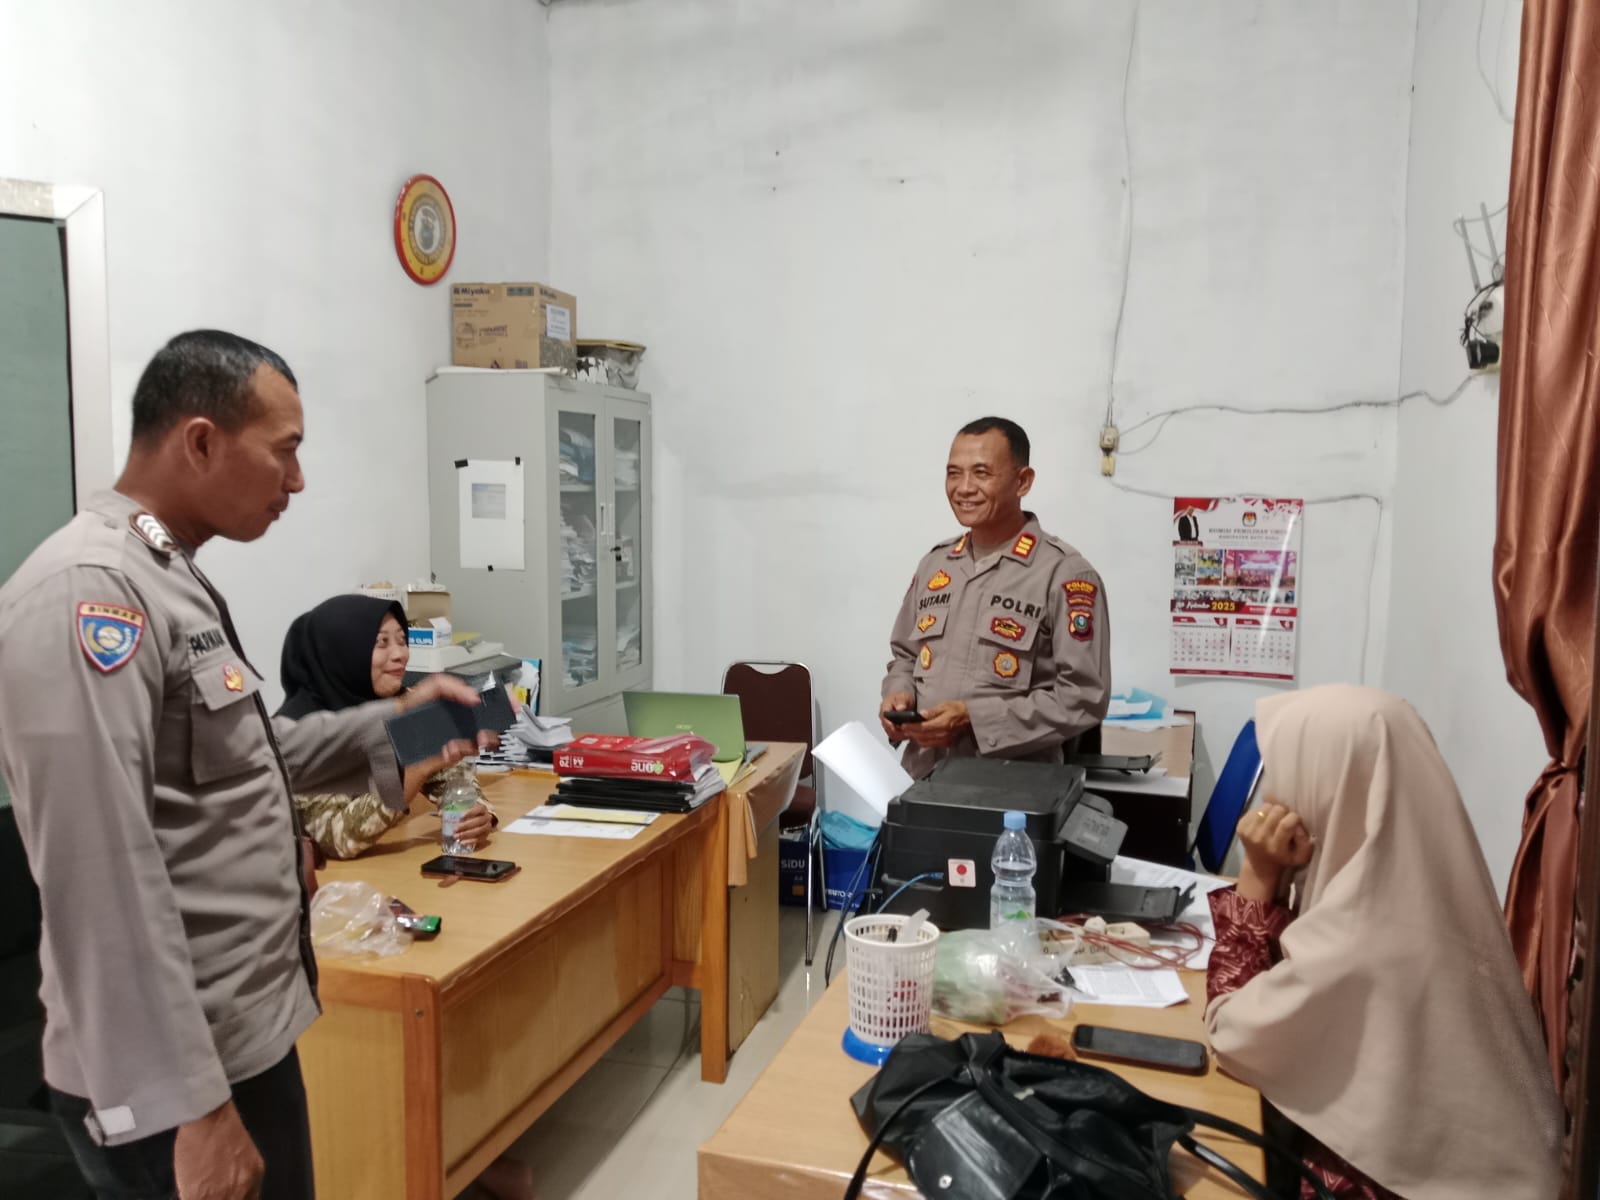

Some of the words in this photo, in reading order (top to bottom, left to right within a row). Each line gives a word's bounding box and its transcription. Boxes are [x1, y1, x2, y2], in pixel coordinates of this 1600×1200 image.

[919, 593, 952, 610] SUTARI
[990, 595, 1042, 619] POLRI
[1211, 601, 1236, 611] 2025
[89, 606, 136, 620] BINMAS
